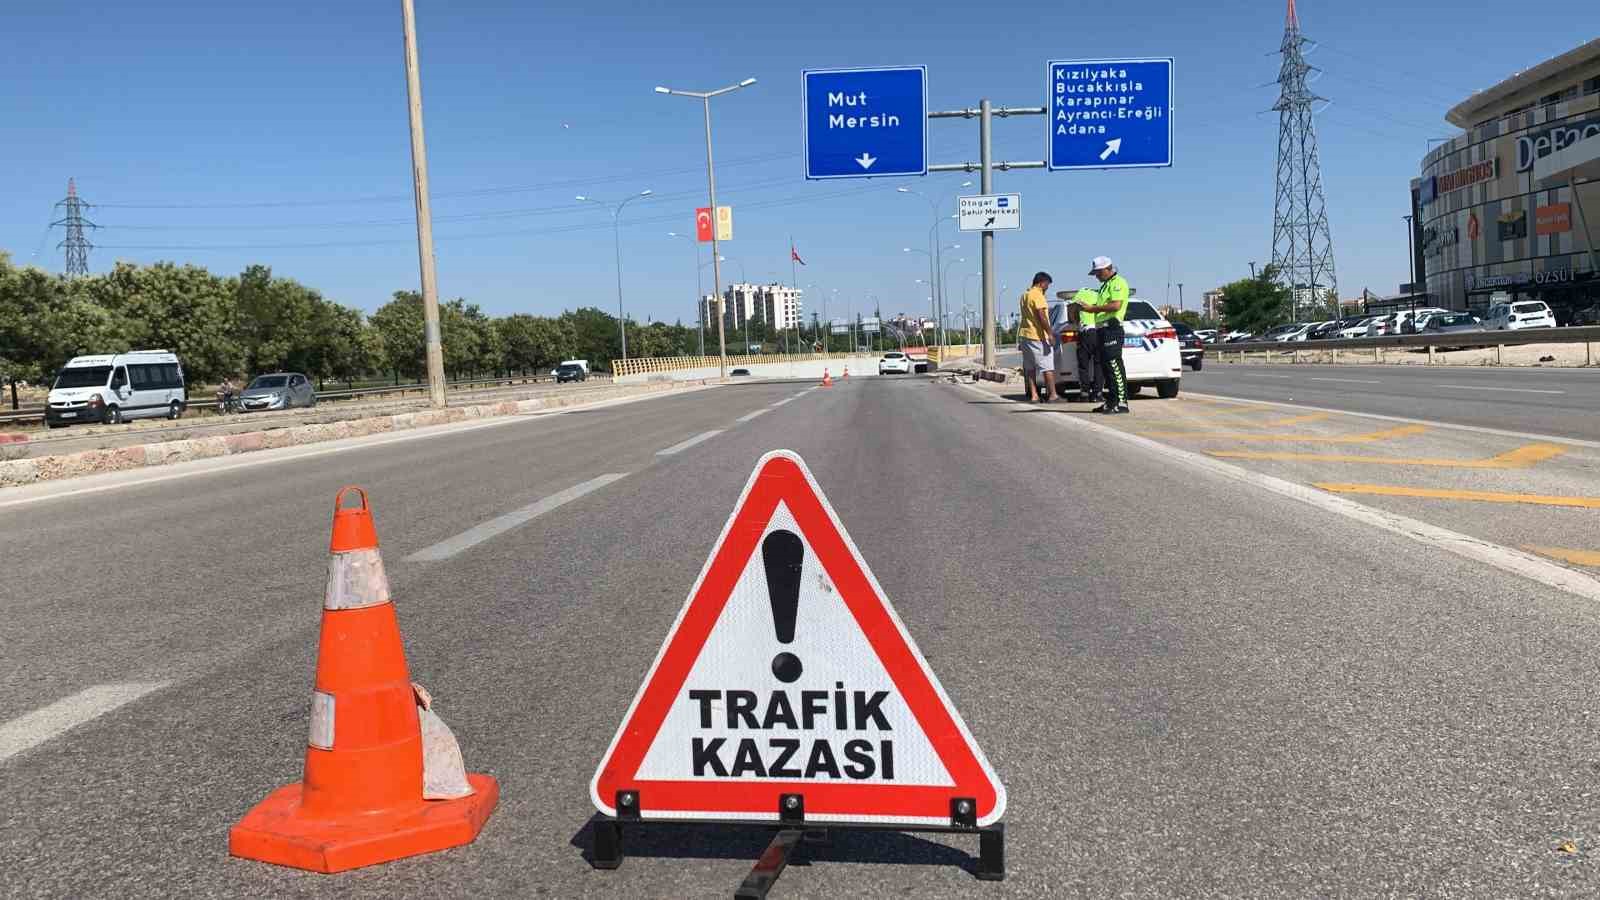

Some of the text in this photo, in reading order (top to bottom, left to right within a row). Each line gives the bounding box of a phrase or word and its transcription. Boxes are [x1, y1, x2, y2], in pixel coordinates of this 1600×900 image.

[1056, 68, 1127, 81] Kızılyaka
[1056, 80, 1143, 93] Bucakkışla
[828, 91, 867, 107] Mut
[1056, 95, 1135, 107] Karapınar
[829, 112, 899, 129] Mersin
[1057, 124, 1106, 135] Adana
[689, 681, 893, 731] TRAFİK
[691, 737, 895, 780] KAZASI
